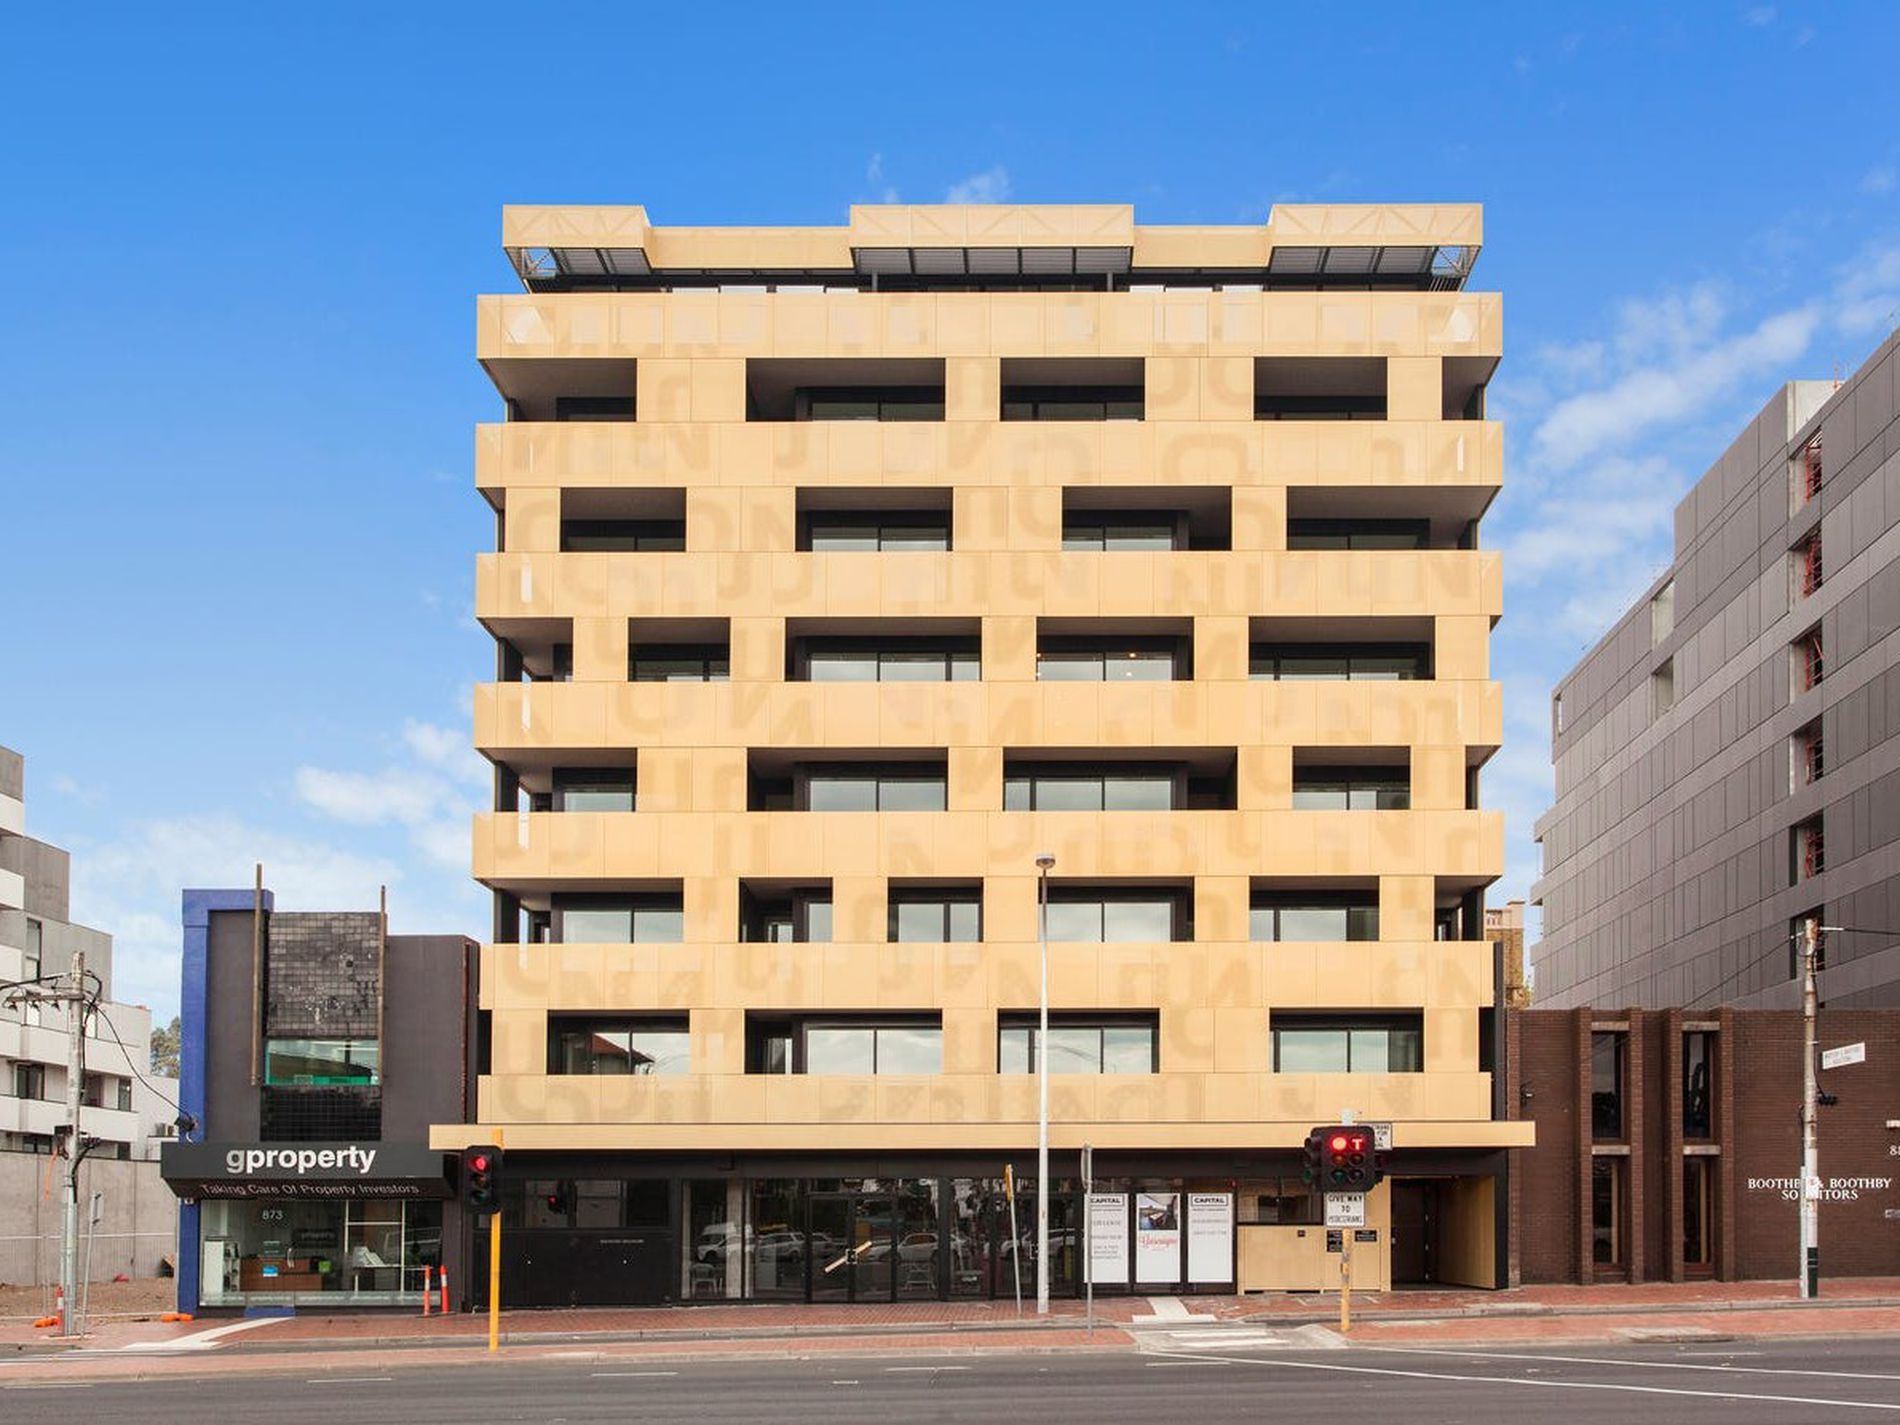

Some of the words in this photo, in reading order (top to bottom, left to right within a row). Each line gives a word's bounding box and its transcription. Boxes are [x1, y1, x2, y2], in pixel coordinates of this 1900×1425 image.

[226, 1146, 376, 1174] gproperty
[201, 1184, 246, 1196] Taking
[248, 1184, 277, 1194] Care
[282, 1184, 298, 1194] Of
[300, 1184, 355, 1196] Property
[359, 1184, 420, 1194] Investors
[1748, 1178, 1801, 1190] BOOTHB
[1829, 1178, 1892, 1189] BOOTHBY
[262, 1209, 284, 1221] 873
